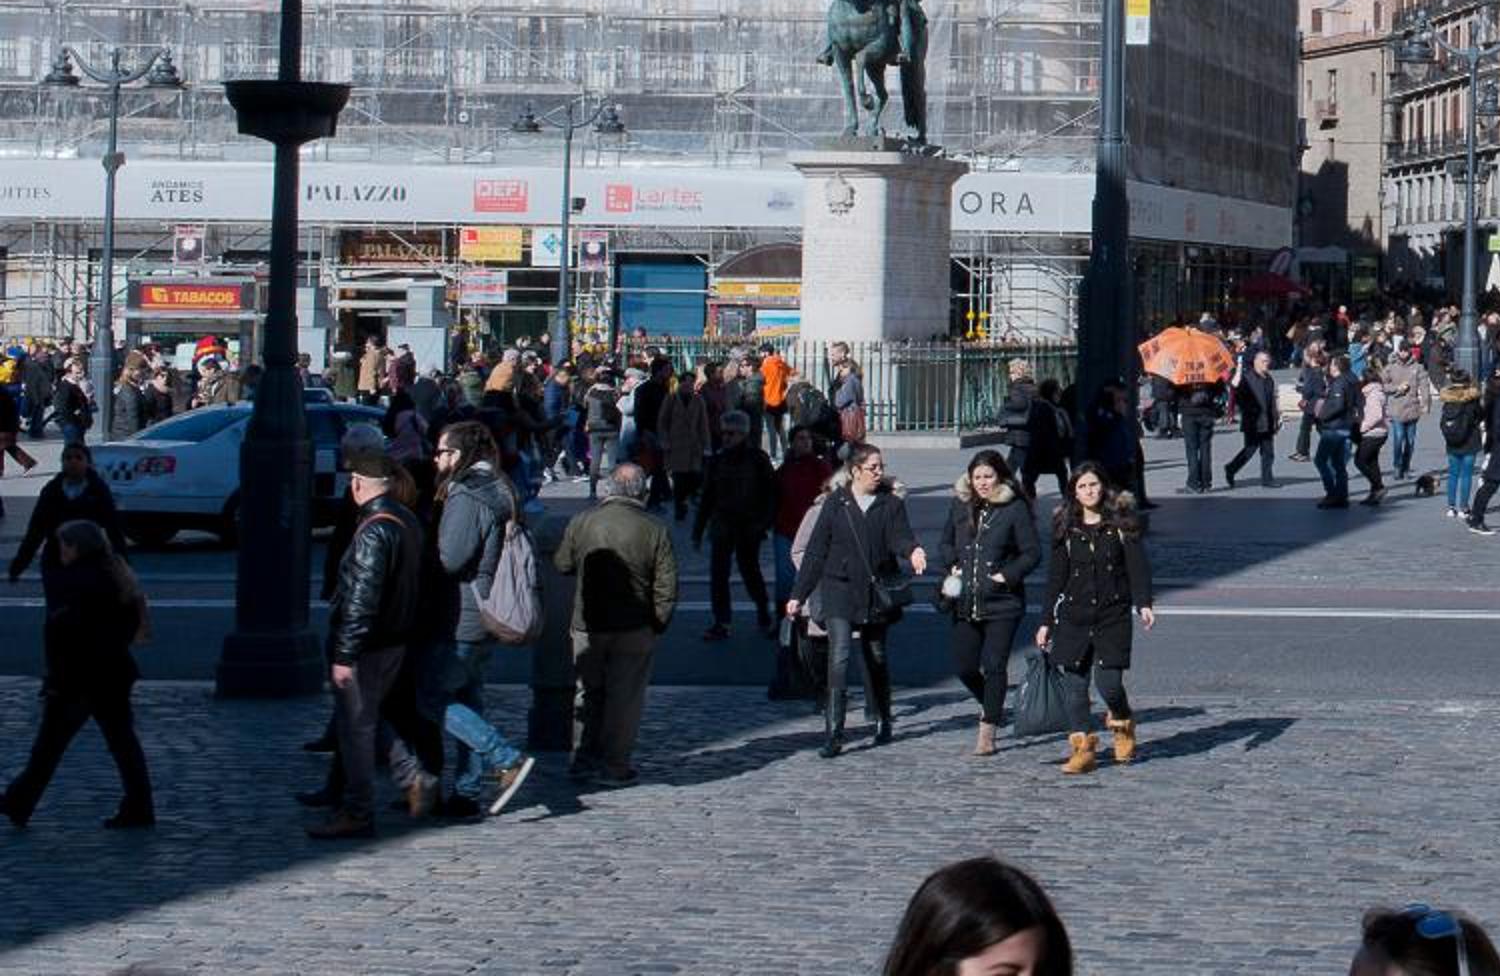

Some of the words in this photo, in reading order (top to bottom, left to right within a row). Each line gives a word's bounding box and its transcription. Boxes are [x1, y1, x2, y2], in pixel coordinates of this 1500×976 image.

[151, 189, 203, 203] ATES
[307, 184, 407, 202] PALAZZO
[362, 243, 439, 258] PALAZZO
[173, 291, 235, 304] TABACOS
